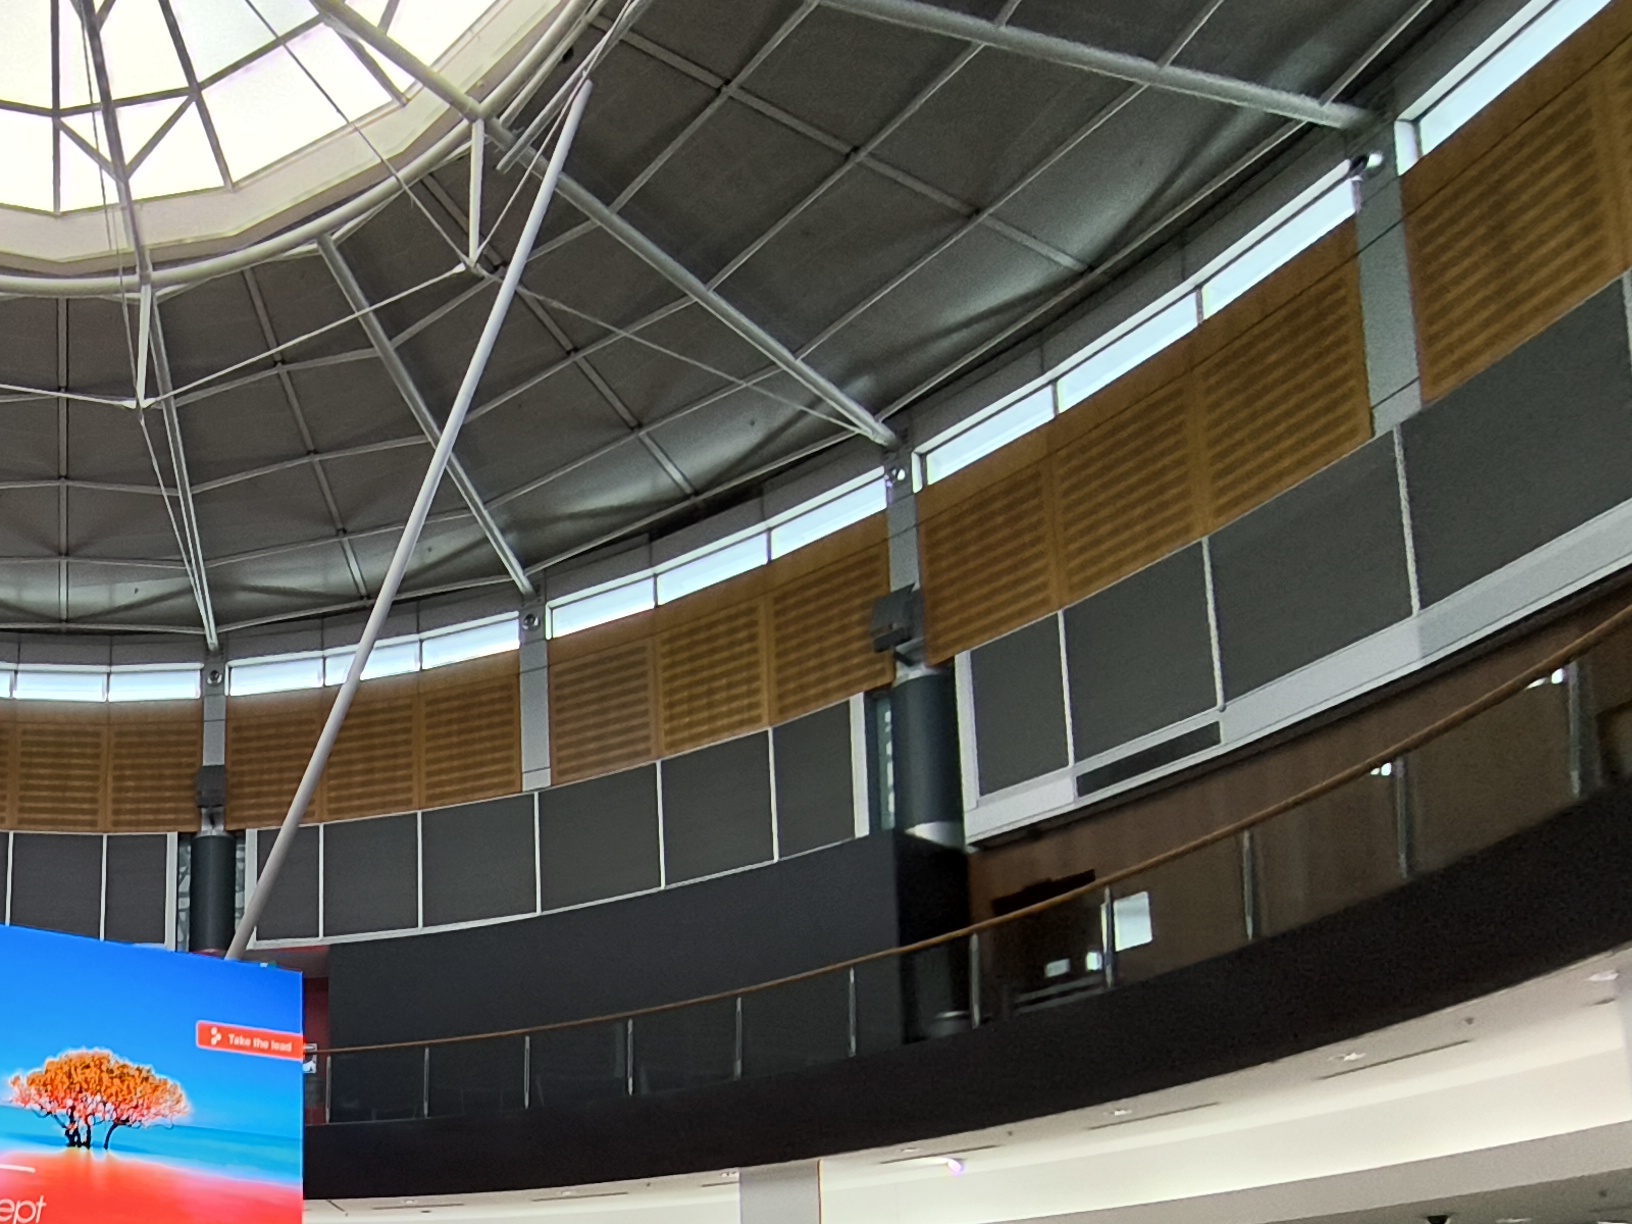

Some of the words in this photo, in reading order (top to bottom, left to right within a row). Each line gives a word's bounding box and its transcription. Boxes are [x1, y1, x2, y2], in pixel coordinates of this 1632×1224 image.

[228, 1033, 252, 1047] Take
[253, 1037, 270, 1050] the
[271, 1040, 293, 1053] lead
